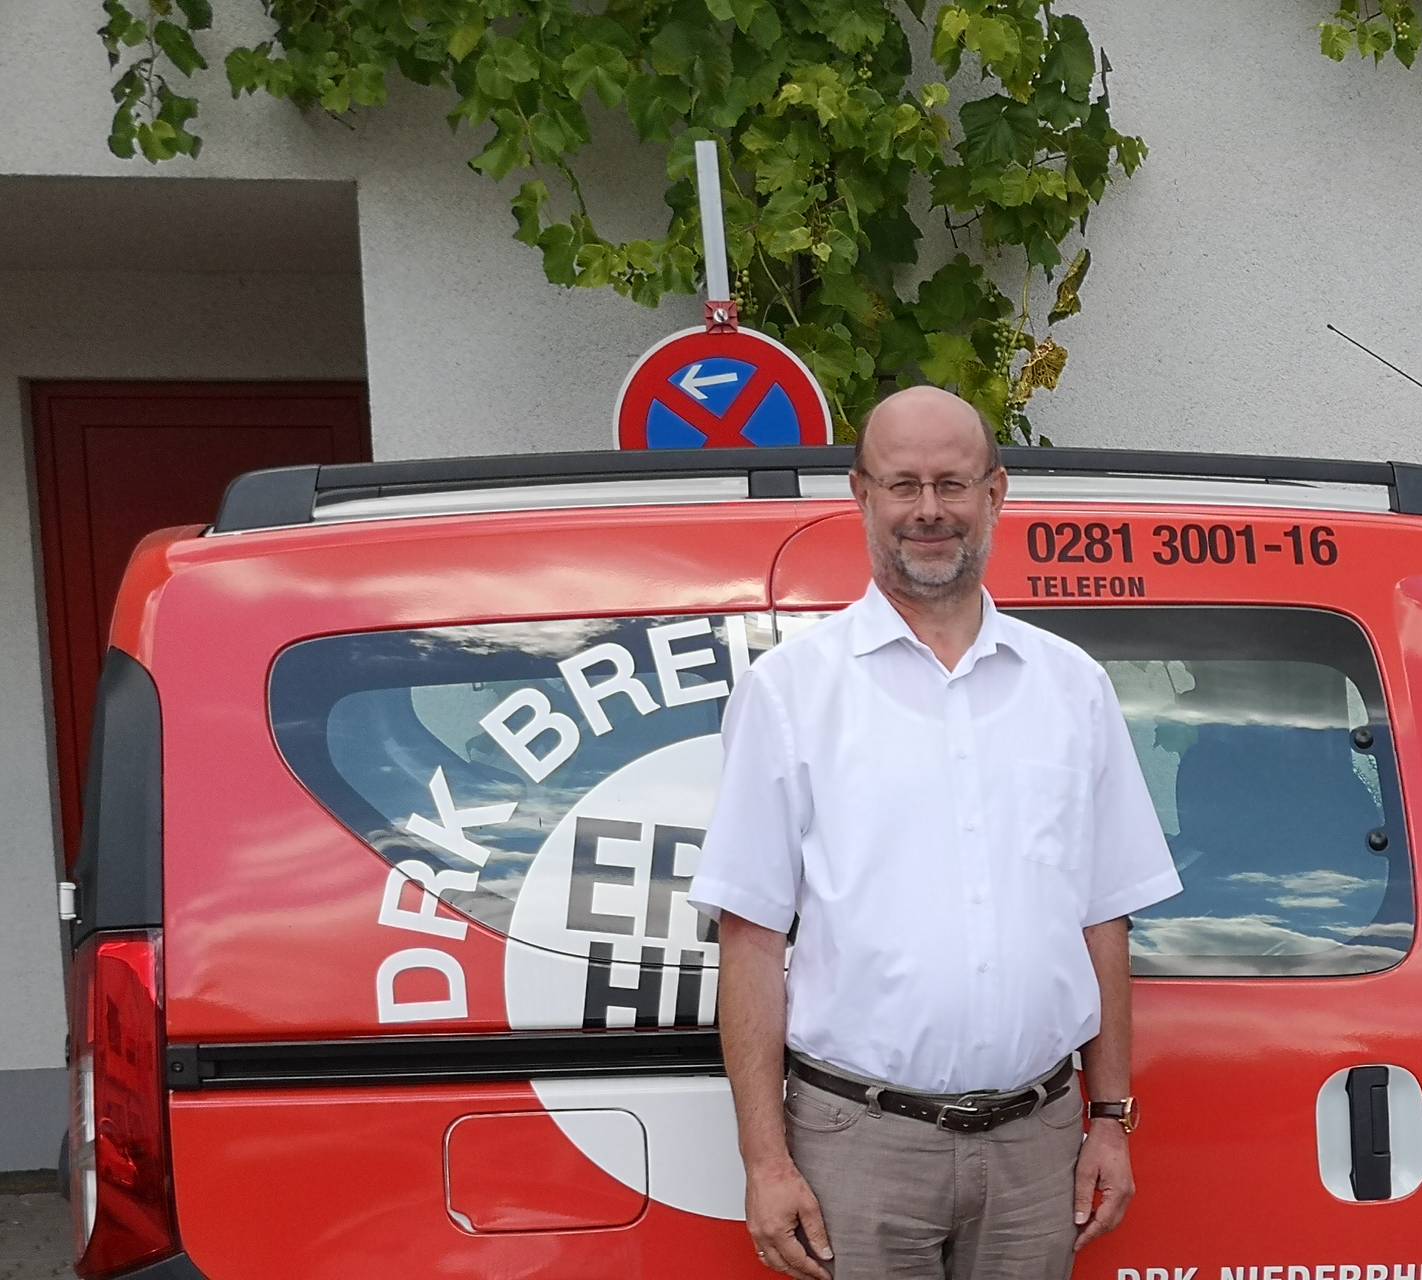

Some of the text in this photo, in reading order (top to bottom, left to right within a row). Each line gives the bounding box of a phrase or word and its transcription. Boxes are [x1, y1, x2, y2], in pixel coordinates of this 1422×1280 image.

[1027, 522, 1338, 566] 0281 3001-16
[1027, 576, 1146, 598] TELEFON
[377, 765, 519, 1024] DRK
[566, 816, 720, 943] ER
[581, 941, 705, 1028] HI
